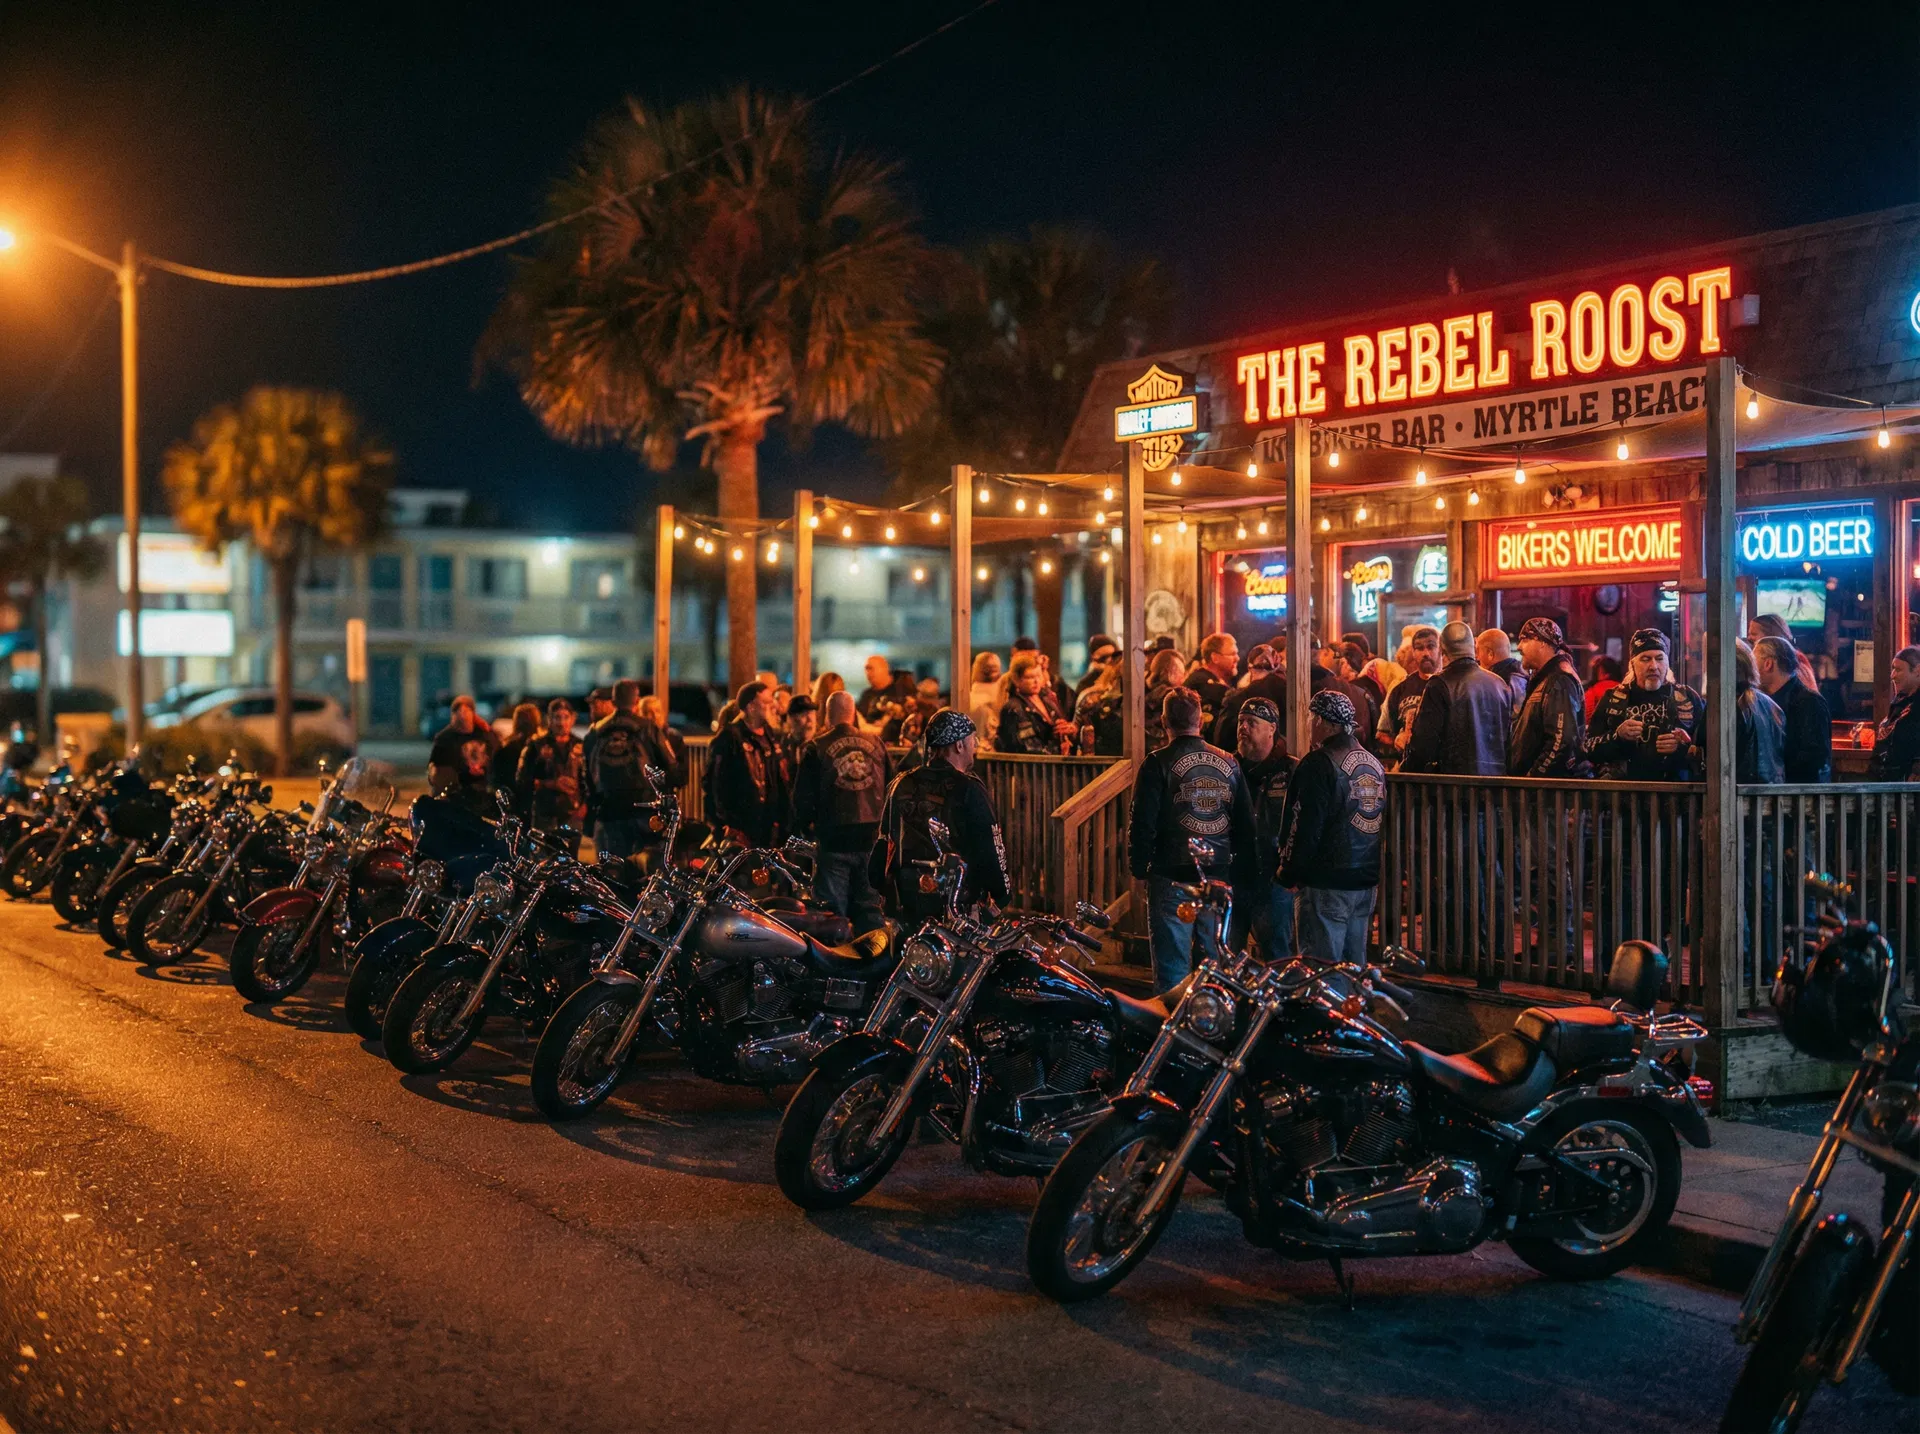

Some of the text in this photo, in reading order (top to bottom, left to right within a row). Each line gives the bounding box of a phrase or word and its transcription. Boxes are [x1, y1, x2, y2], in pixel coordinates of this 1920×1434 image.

[1237, 266, 1732, 424] THE REBEL ROOST
[1392, 413, 1446, 447] BAR
[1473, 391, 1599, 439] MYRTLE
[1611, 375, 1707, 422] BEAC
[1498, 521, 1682, 570] BIKERS WELCOME
[1742, 518, 1873, 561] COLD BEER
